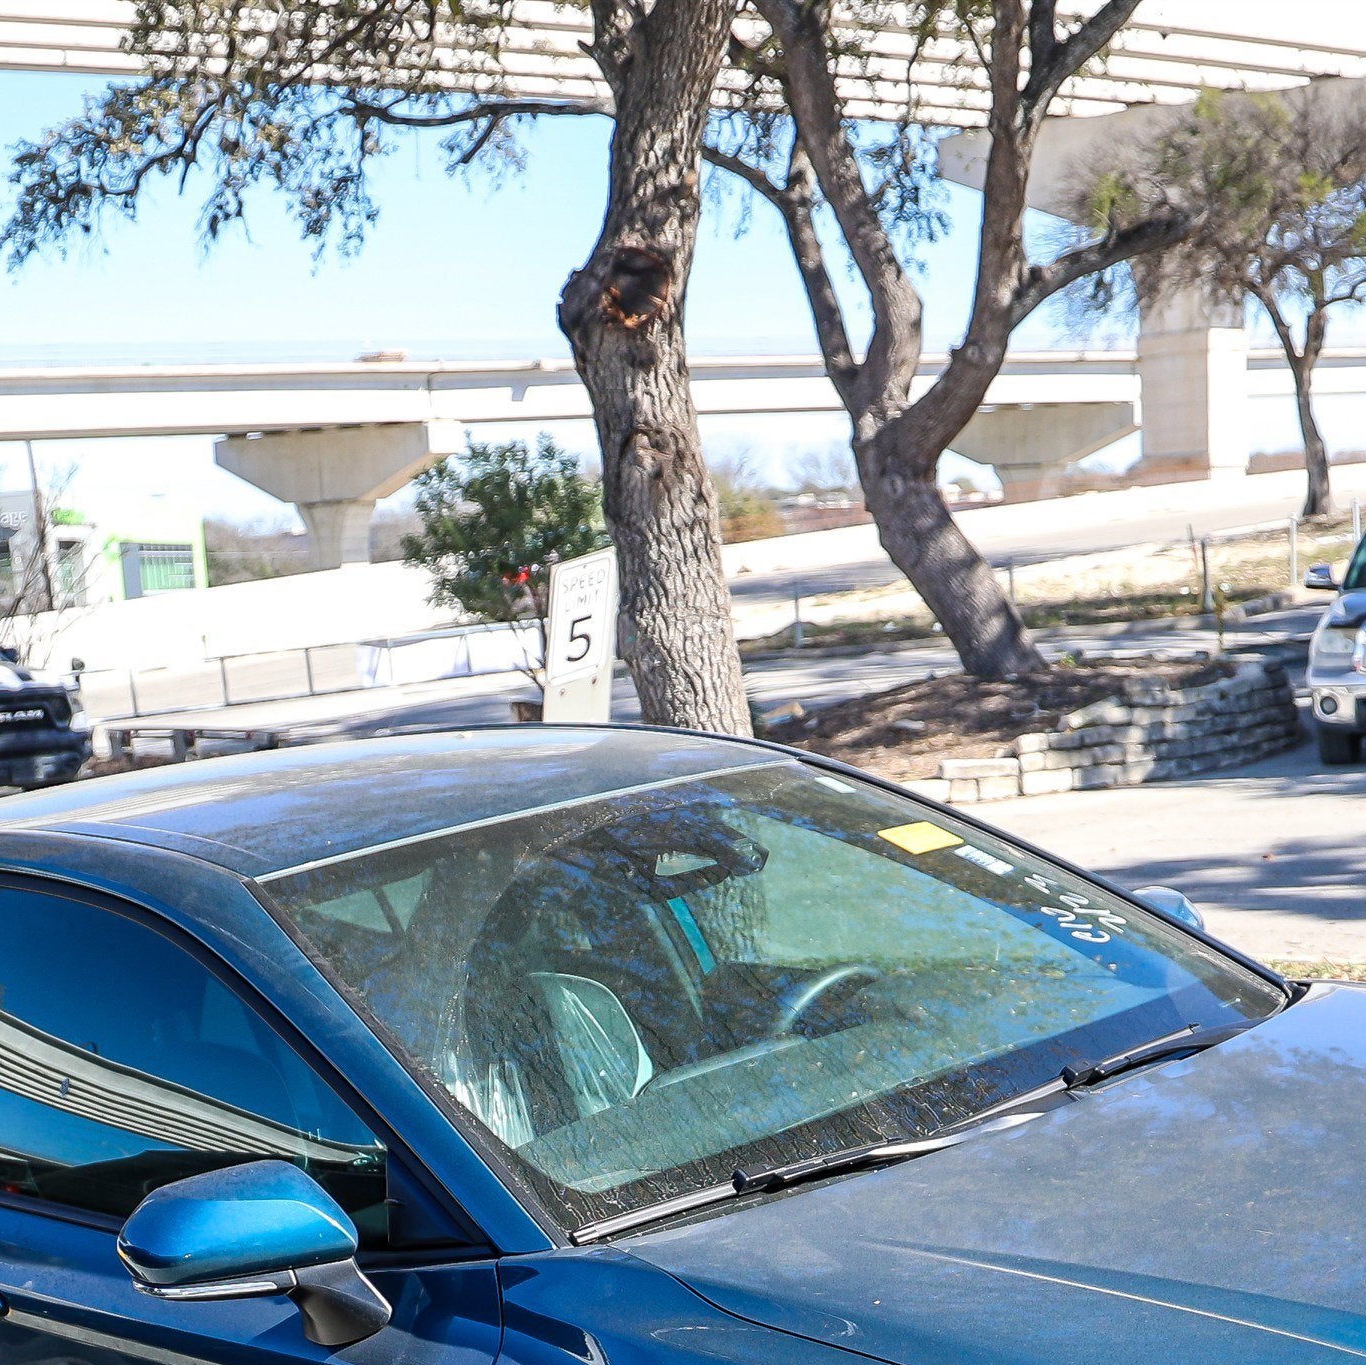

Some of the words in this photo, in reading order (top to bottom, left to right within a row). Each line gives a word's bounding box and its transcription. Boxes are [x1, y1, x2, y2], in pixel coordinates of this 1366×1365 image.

[562, 568, 606, 594] SPEED
[565, 588, 602, 613] LIMIT
[566, 614, 592, 662] 5
